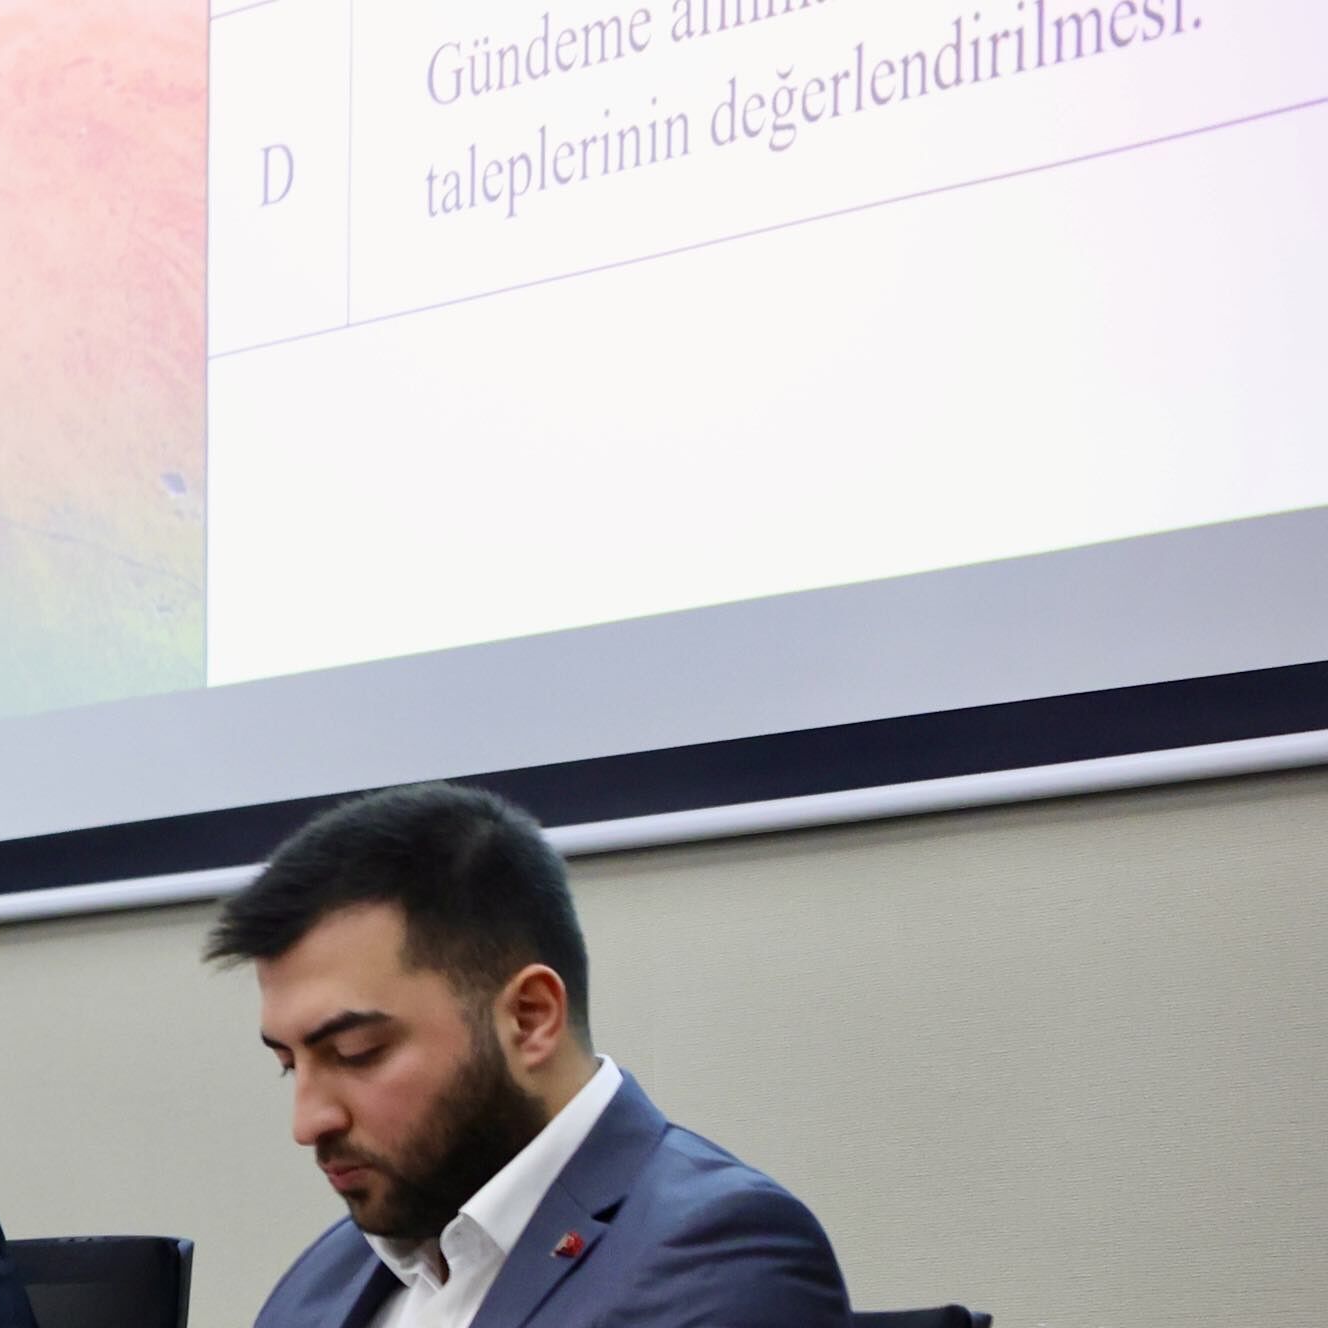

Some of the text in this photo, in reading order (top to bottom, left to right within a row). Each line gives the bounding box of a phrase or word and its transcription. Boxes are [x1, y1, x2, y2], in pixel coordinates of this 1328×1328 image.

[427, 8, 652, 105] Gündeme
[259, 143, 295, 207] D
[425, 96, 691, 219] taleplerinin
